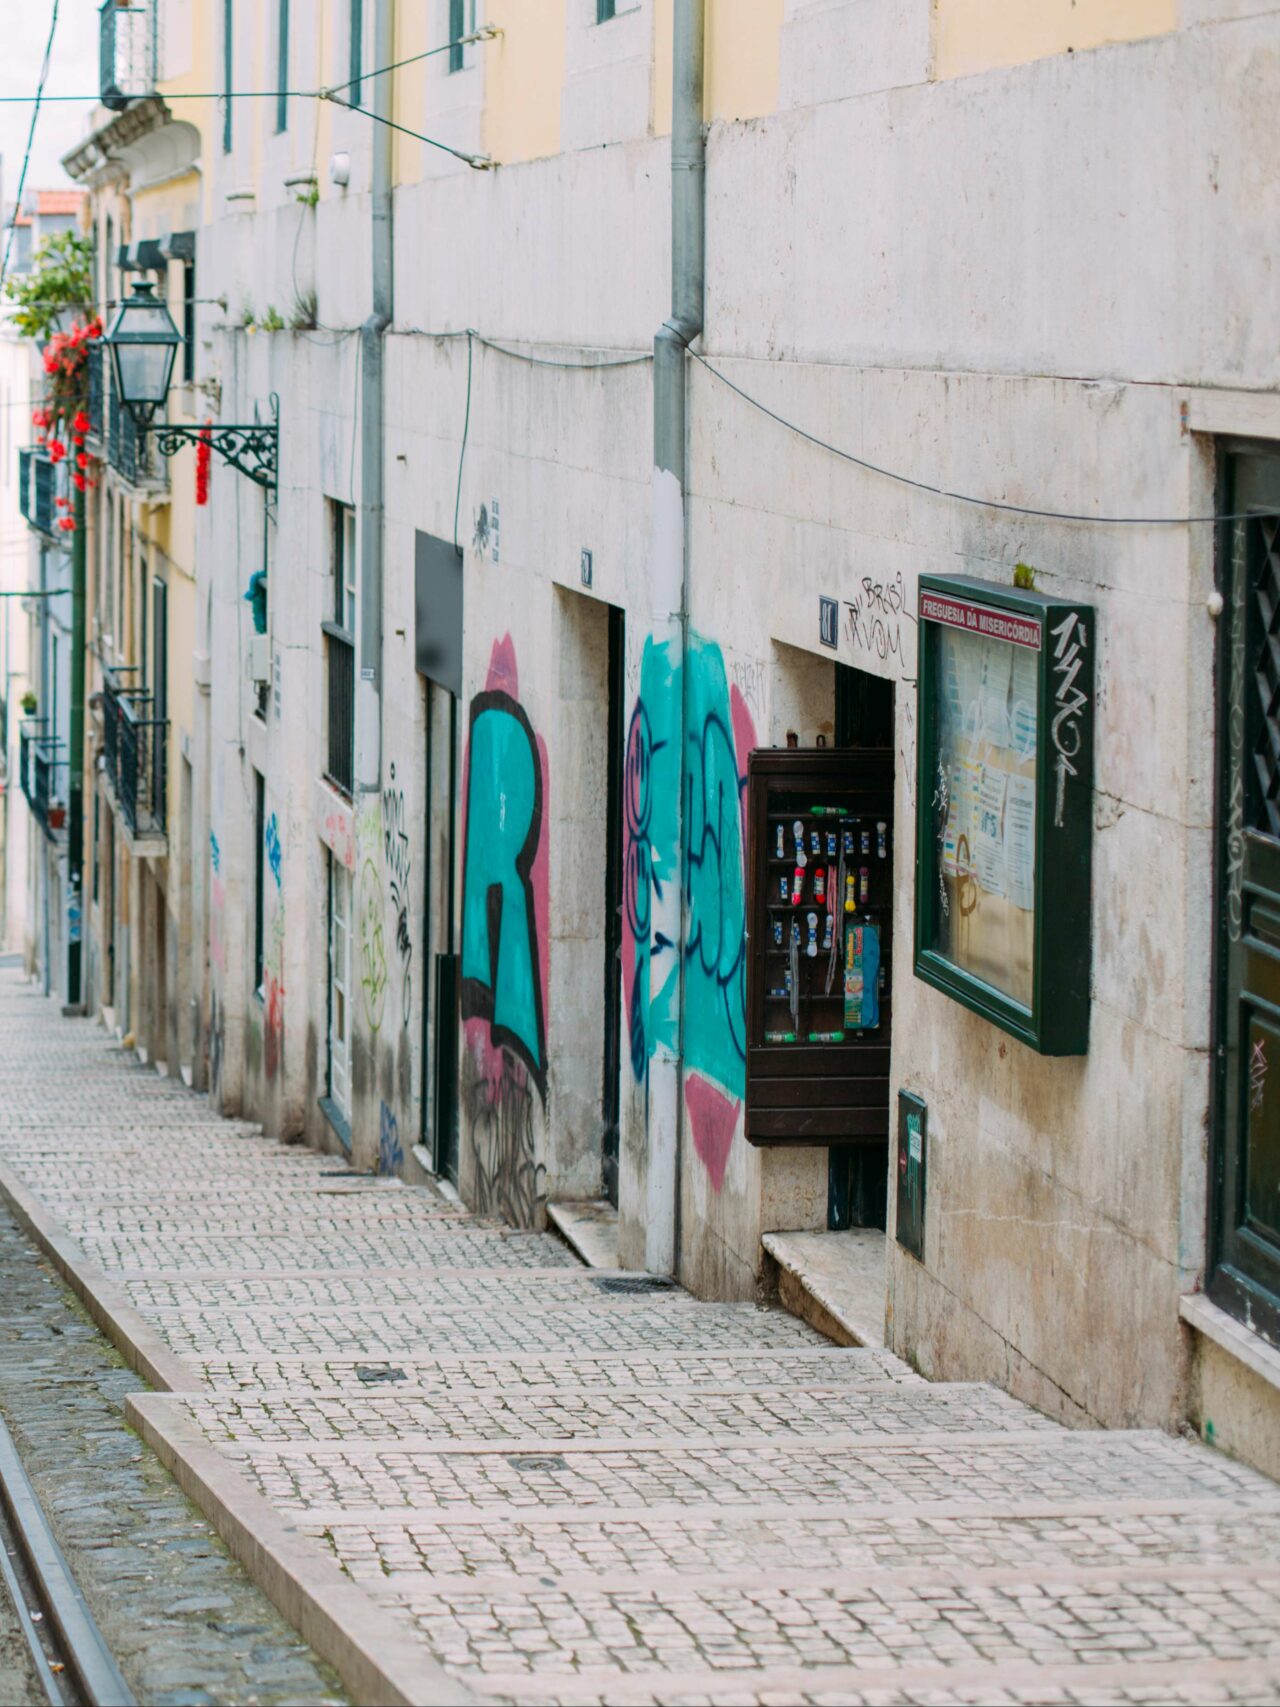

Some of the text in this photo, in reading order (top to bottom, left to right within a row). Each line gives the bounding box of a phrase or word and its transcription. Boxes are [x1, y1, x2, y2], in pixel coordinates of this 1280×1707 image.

[821, 602, 833, 642] 81
[922, 599, 966, 625] FREGUESIA
[978, 613, 1040, 645] MISERICÓRDIA
